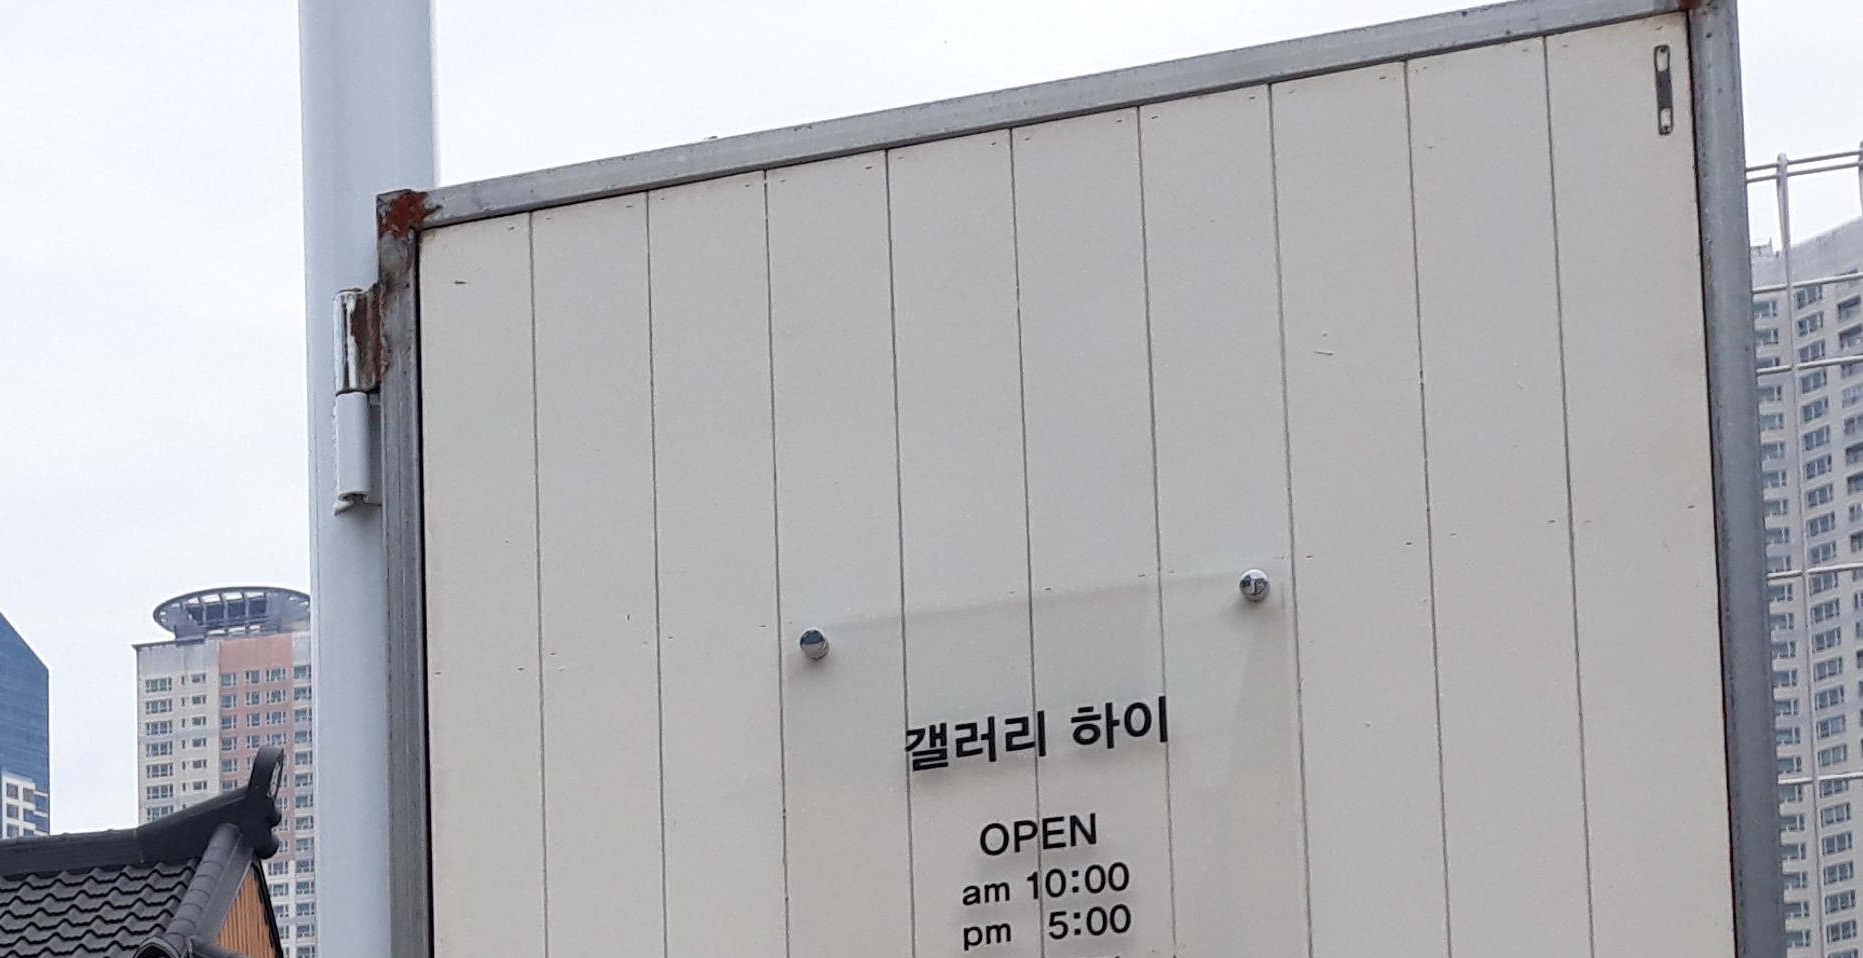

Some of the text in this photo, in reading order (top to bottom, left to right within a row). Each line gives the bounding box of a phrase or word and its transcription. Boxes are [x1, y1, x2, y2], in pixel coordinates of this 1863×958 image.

[905, 695, 1168, 772] 갤러리 하이
[979, 812, 1097, 856] OPEN
[962, 861, 1130, 906] am 10:00
[963, 903, 1131, 952] pm 5:00
